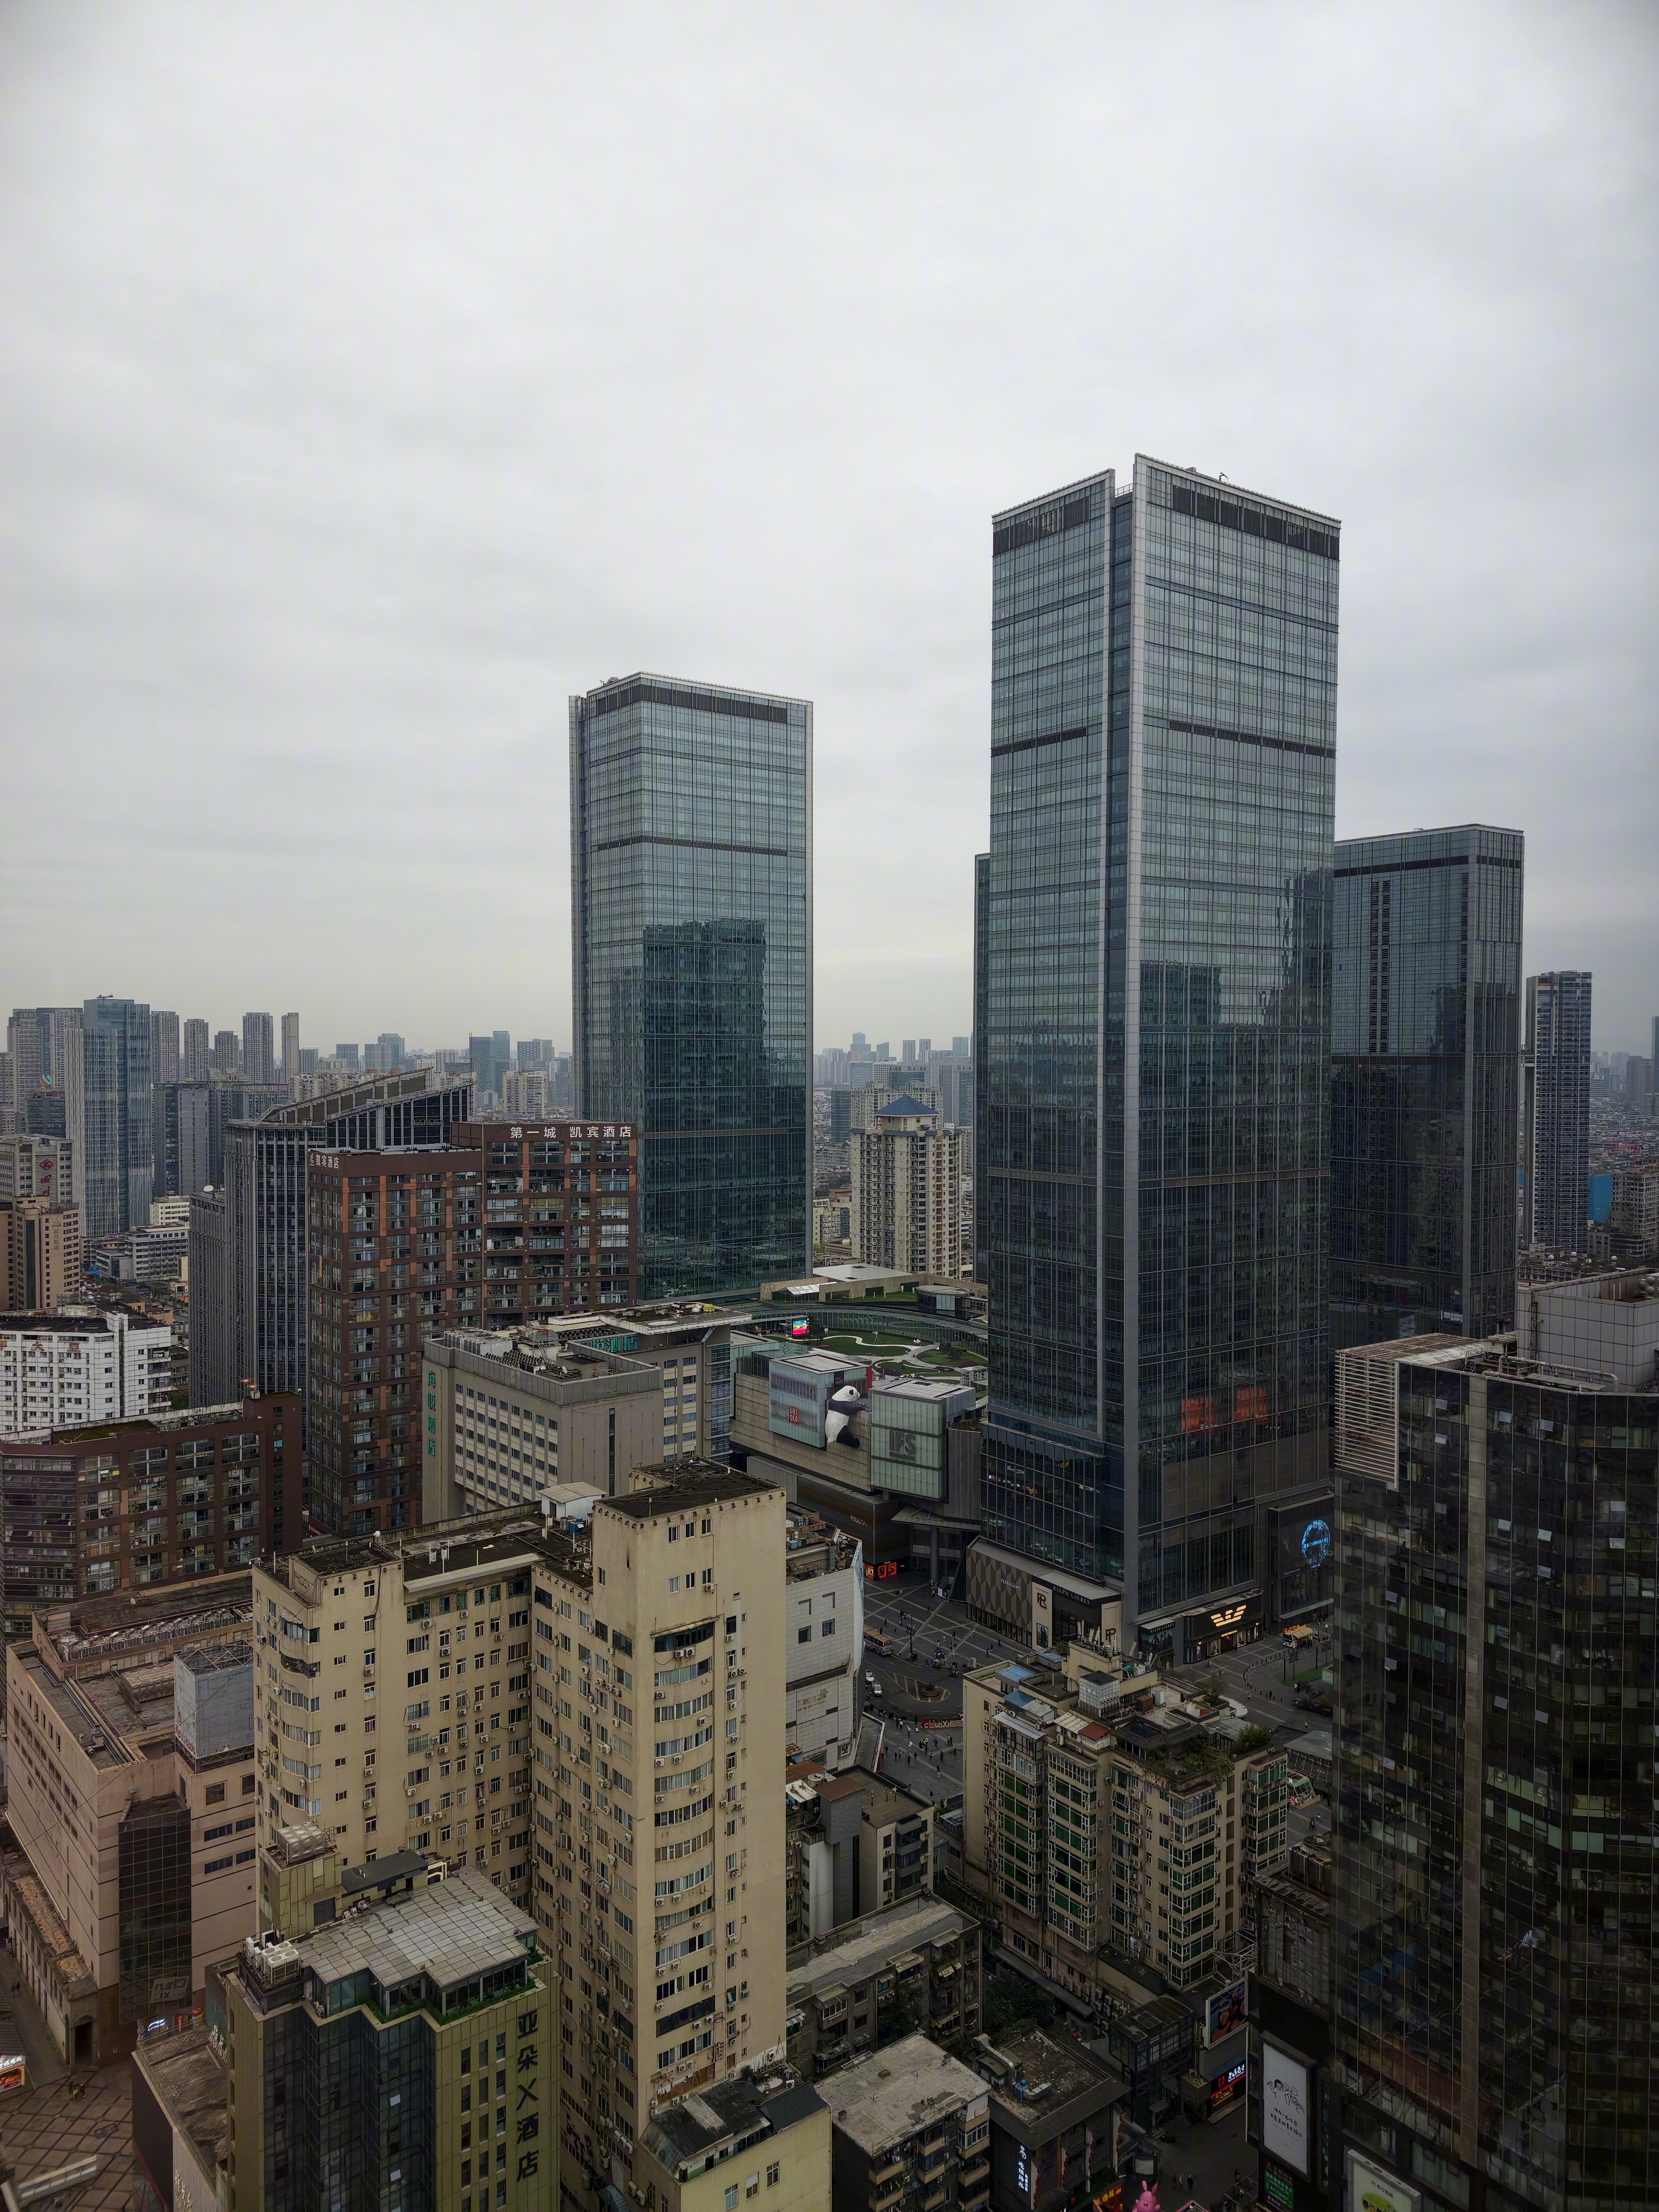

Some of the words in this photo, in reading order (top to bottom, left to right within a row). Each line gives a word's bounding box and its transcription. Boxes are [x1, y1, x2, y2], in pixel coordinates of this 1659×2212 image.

[510, 1127, 556, 1138] 第一城
[569, 1126, 631, 1138] 凯宾酒店
[316, 1154, 339, 1169] 凯宾酒店
[578, 1334, 637, 1353] 悦酒店
[889, 1429, 916, 1455] IFS
[850, 1515, 867, 1527] PRADA
[1001, 1579, 1022, 1591] FERRAGAMO
[1053, 1586, 1069, 1597] RALPH
[1071, 1594, 1090, 1606] LAUREN
